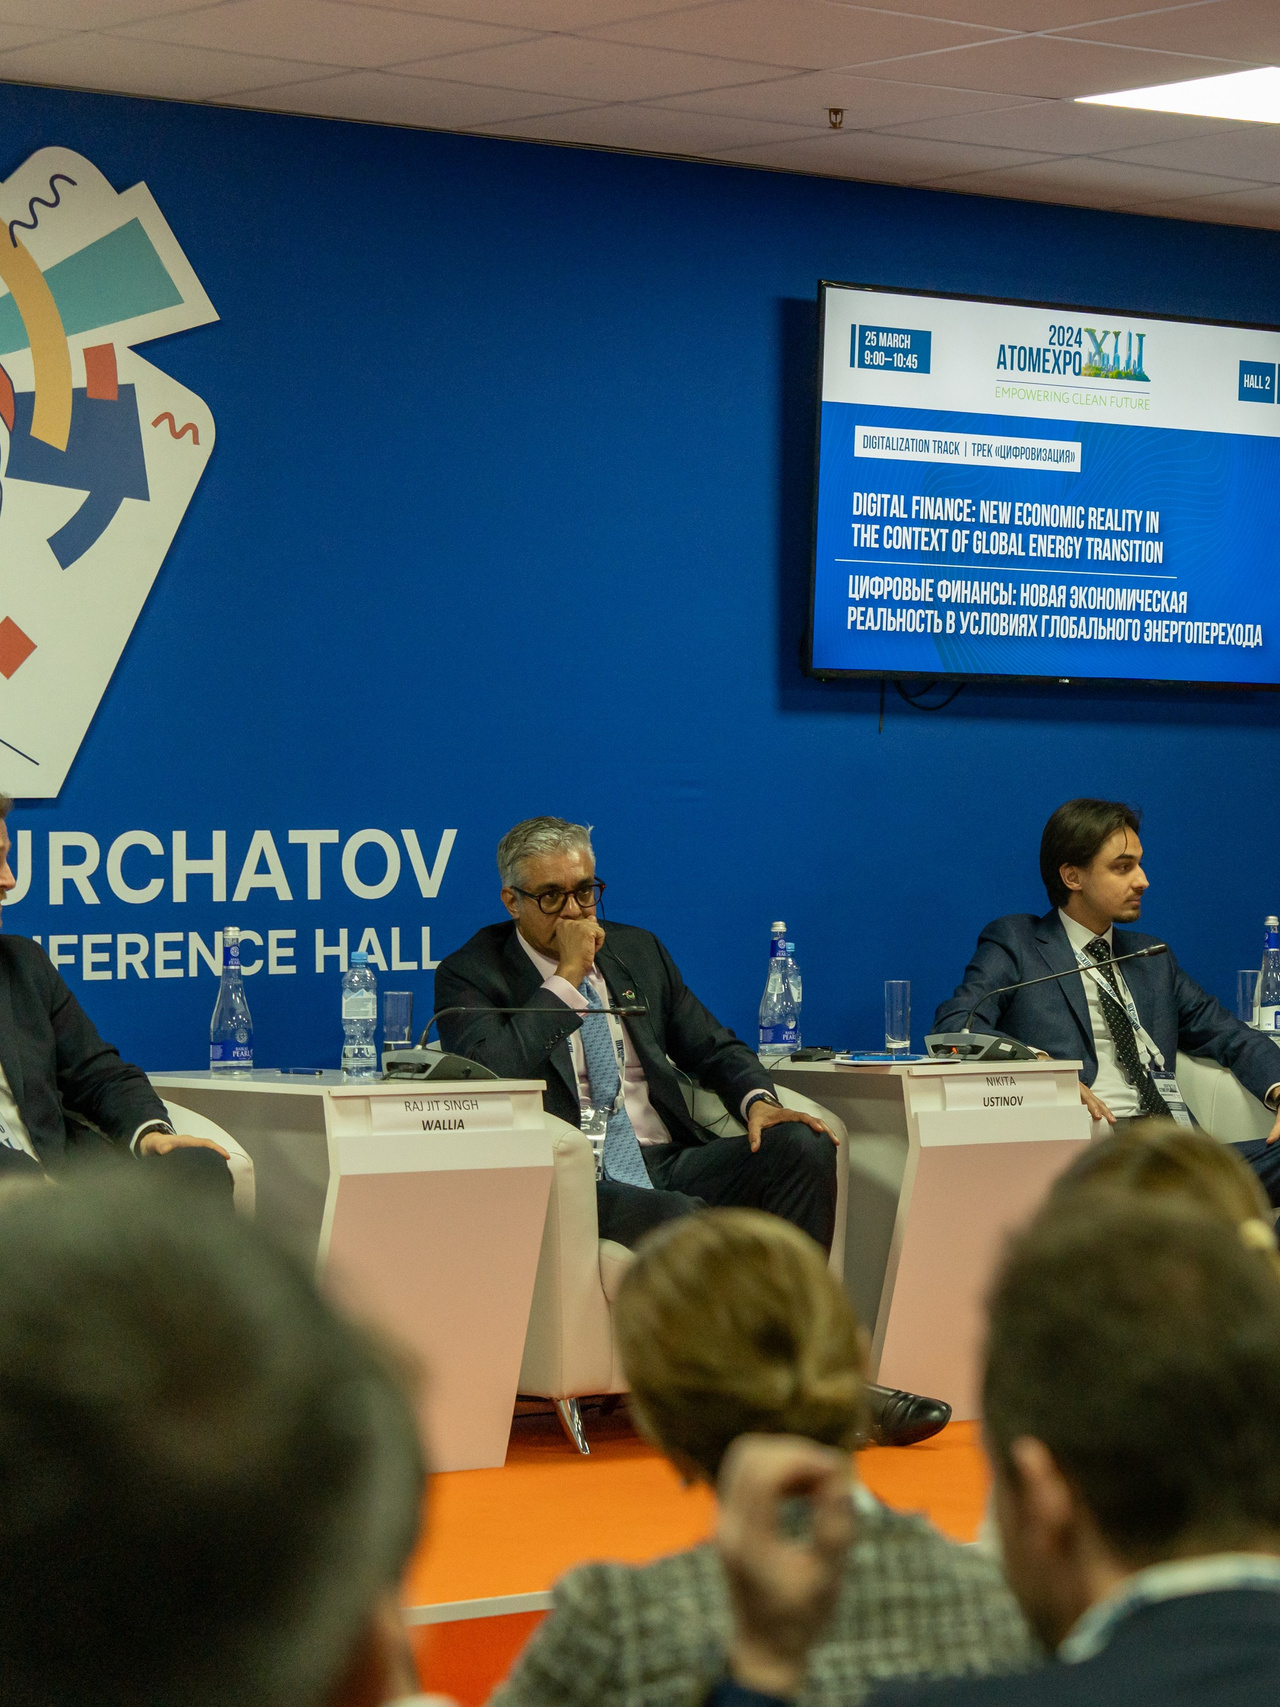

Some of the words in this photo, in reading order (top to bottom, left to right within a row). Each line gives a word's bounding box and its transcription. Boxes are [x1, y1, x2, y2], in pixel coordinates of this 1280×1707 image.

[865, 331, 877, 346] 25
[879, 332, 911, 349] MARCH
[1049, 324, 1082, 348] 2024
[996, 344, 1082, 376] ATOMEXPO
[1244, 374, 1263, 389] HALL
[1265, 376, 1271, 390] 2
[995, 386, 1069, 404] EMPOWERING
[1072, 392, 1107, 407] CLEAN
[1110, 396, 1150, 410] FUTURE
[862, 434, 930, 453] DIGITALIZATION
[932, 440, 960, 456] TRACK
[972, 442, 993, 458] ТРЕК
[995, 445, 1076, 464] «ЦИФРОВИЗАЦИЯ»
[852, 492, 908, 519] DIGITAL
[911, 496, 976, 523] FINANCE:
[979, 500, 1012, 525] NEW
[1014, 502, 1085, 530] ECONOMIC
[1088, 507, 1143, 533] REALITY
[1146, 511, 1160, 534] IN
[852, 523, 880, 549] THE
[883, 525, 949, 552] CONTEXT
[952, 529, 970, 553] OF
[973, 530, 1026, 557] GLOBAL
[1029, 534, 1083, 560] ENERGY
[1086, 537, 1164, 564] TRANSITION
[848, 575, 935, 602] ЦИФРОВЫЕ
[937, 579, 1017, 606] ФИНАНСЫ:
[1020, 583, 1067, 608] НОВАЯ
[1070, 585, 1188, 614] ЭКОНОМИЧЕСКАЯ
[847, 606, 943, 634] РЕАЛЬНОСТЬ
[946, 611, 956, 634] В
[959, 611, 1038, 638] УСЛОВИЯХ
[1040, 615, 1140, 642] ГЛОБАЛЬНОГО
[1144, 619, 1263, 649] ЭНЕРГОПЕРЕХОДА
[315, 926, 443, 973] HALL
[985, 1076, 1016, 1087] NIKITA
[404, 1100, 424, 1112] RAJ
[426, 1100, 442, 1111] JIT
[444, 1099, 479, 1111] SINGH
[983, 1096, 1024, 1107] USTINOV
[421, 1119, 465, 1131] WALLIA
